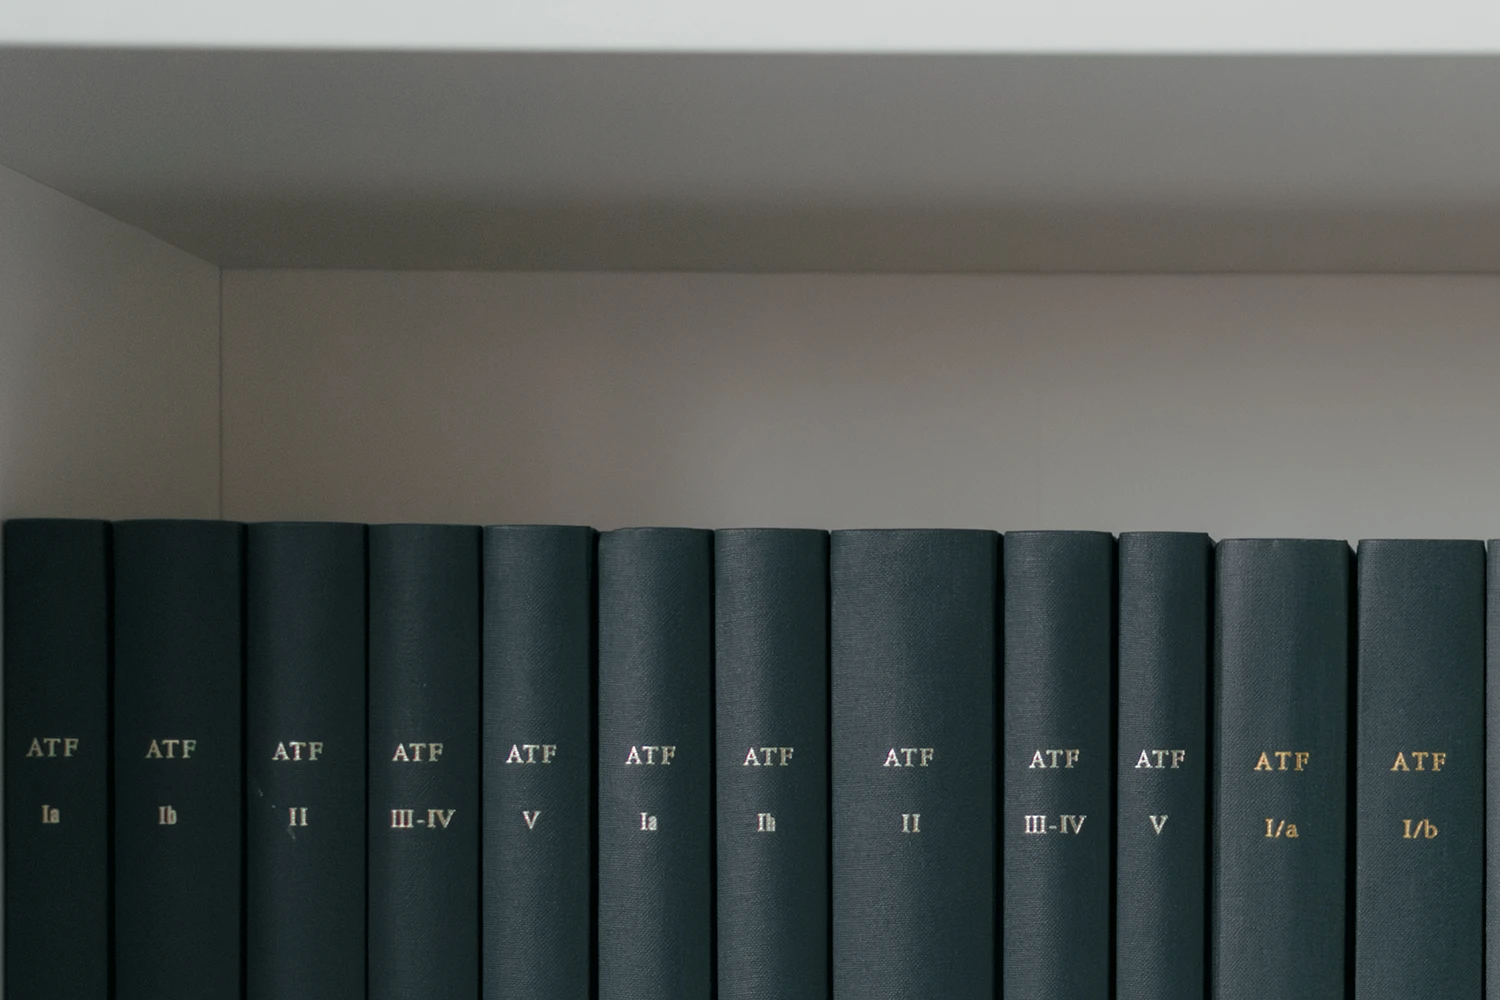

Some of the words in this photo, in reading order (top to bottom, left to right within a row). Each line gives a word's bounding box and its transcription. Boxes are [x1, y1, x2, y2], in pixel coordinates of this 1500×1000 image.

[26, 737, 79, 757] ATF
[145, 739, 197, 759] ATF
[271, 740, 324, 762] ATF
[391, 742, 444, 763] ATF
[505, 743, 557, 765] ATF
[624, 745, 677, 766] ATF
[742, 746, 795, 767] ATF
[882, 747, 935, 768] ATF
[1028, 748, 1080, 769] ATF
[1134, 748, 1186, 769] ATF
[1253, 750, 1310, 772] ATF
[1389, 751, 1447, 772] ATF
[41, 804, 60, 824] Ia
[158, 804, 178, 825] Ib
[288, 806, 309, 827] II
[390, 808, 457, 829] III-IV
[522, 810, 542, 830] V
[639, 811, 658, 832] Ia
[901, 813, 921, 834] II
[1023, 814, 1088, 835] III-IV
[1148, 814, 1169, 835] V
[1264, 817, 1300, 839] I/a
[1402, 818, 1439, 840] I/b
